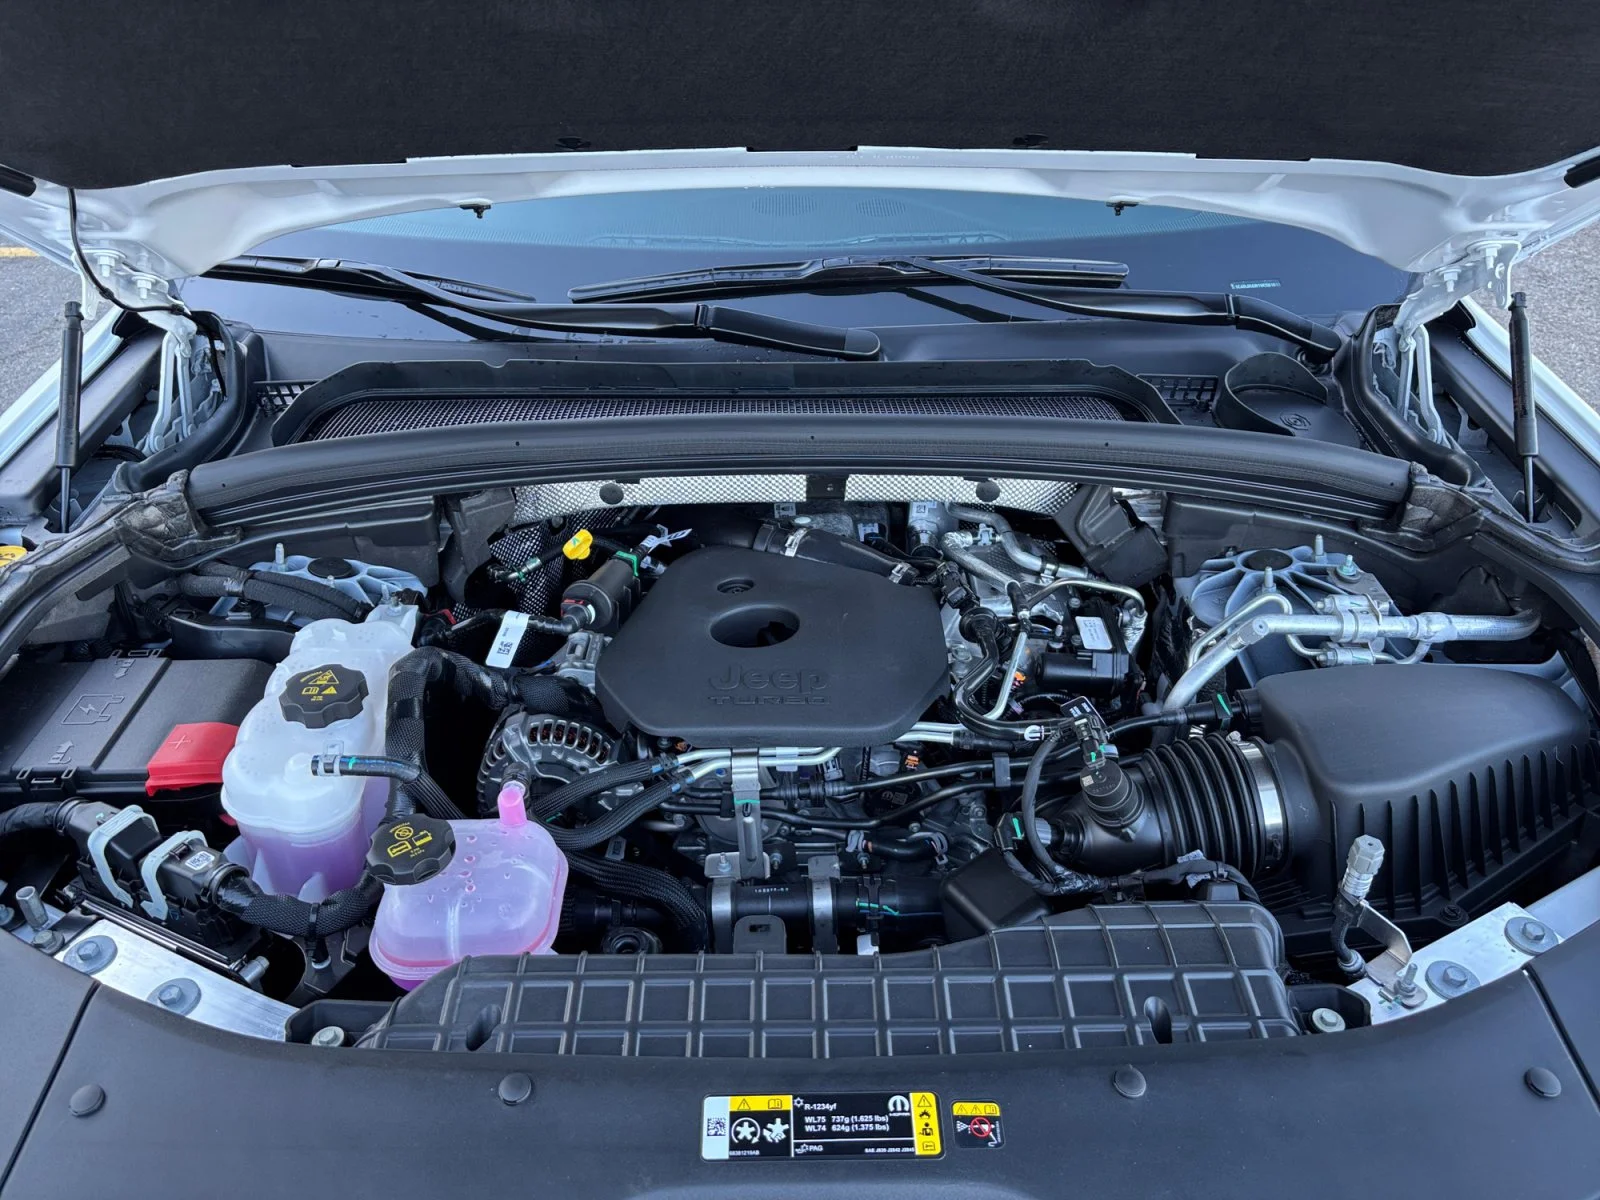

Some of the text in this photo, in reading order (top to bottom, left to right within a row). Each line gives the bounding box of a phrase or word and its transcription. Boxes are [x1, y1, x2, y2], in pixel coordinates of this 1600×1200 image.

[708, 664, 830, 695] Jeep
[707, 695, 830, 705] TURBO
[804, 1103, 837, 1111] R-1234yf
[831, 1115, 850, 1123] 737g
[851, 1115, 873, 1123] (1.625
[874, 1114, 889, 1123] lbs)
[831, 1124, 850, 1132] 624g
[851, 1124, 873, 1132] (1.375
[875, 1123, 890, 1132] lbs)
[809, 1144, 824, 1152] PAG
